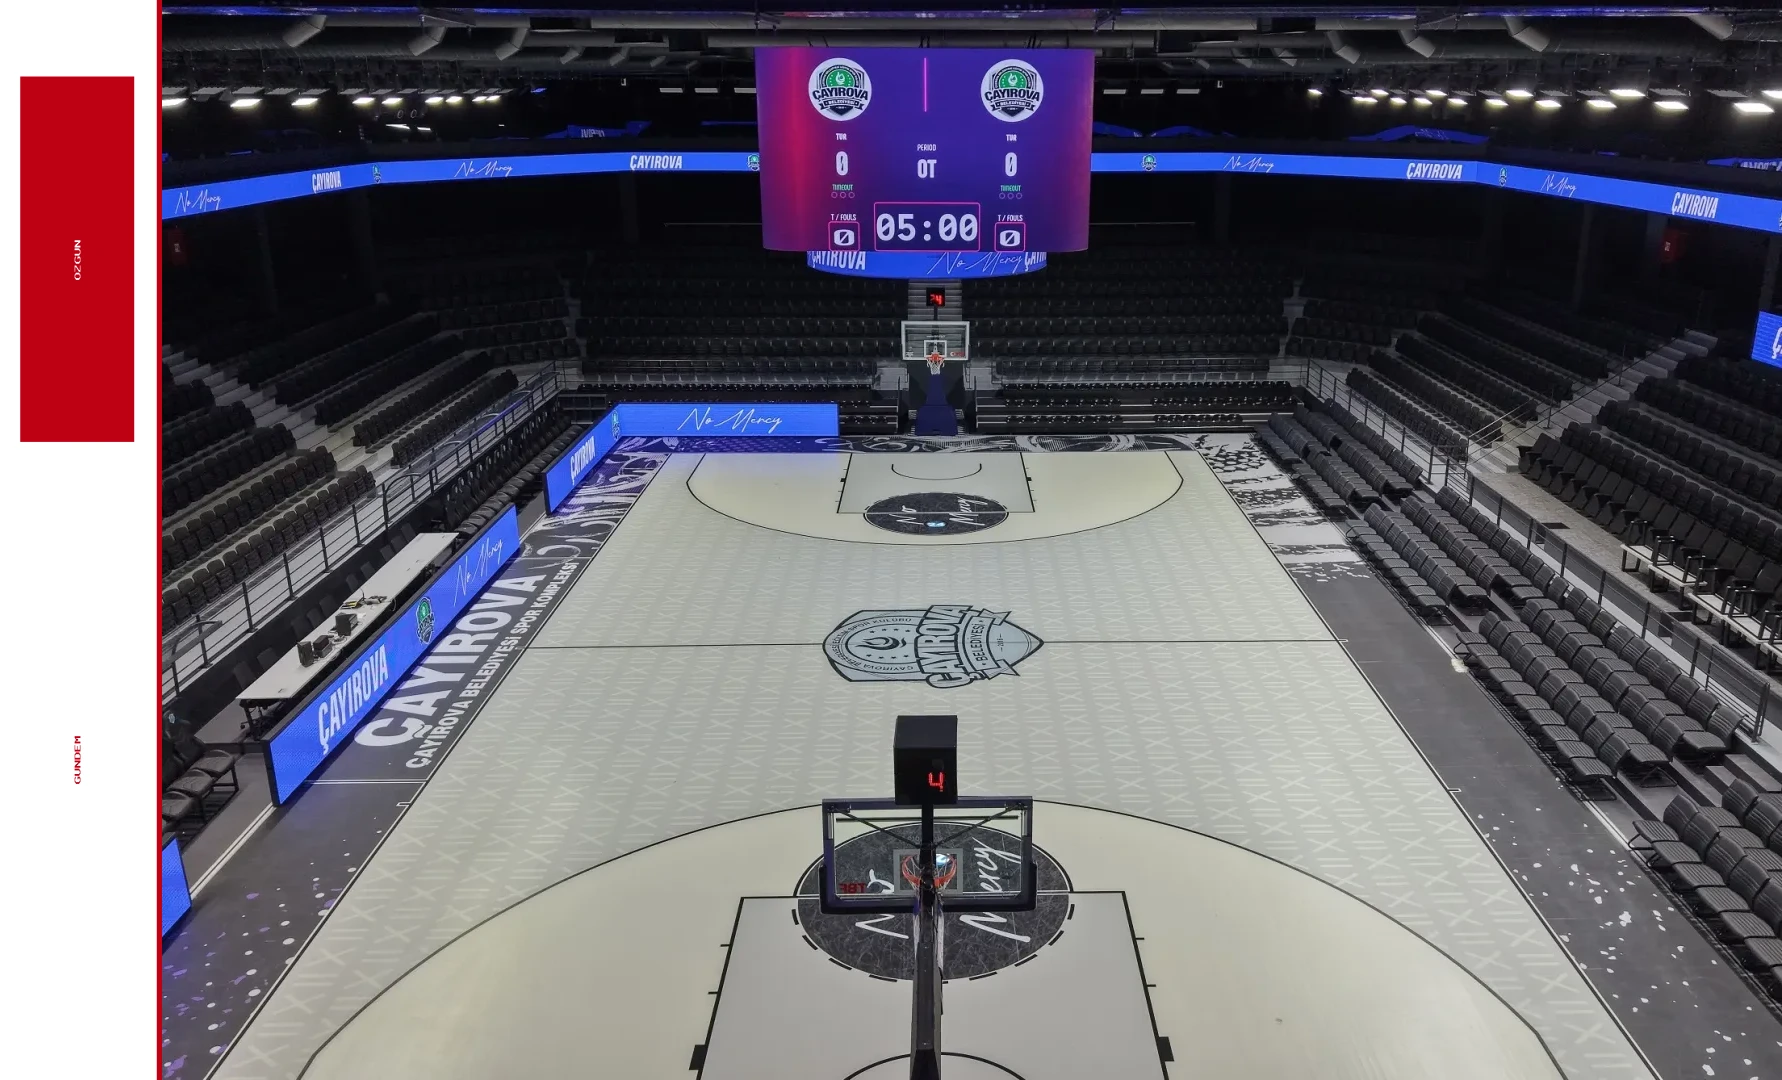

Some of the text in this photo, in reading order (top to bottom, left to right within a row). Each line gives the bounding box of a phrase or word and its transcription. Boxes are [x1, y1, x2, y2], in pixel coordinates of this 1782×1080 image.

[812, 87, 868, 102] ÇAYIROVA
[984, 88, 1040, 103] ÇAYIROVA
[454, 160, 513, 178] No Mercy
[630, 154, 682, 172] ÇAYIROVA
[836, 151, 848, 176] 0
[917, 159, 937, 178] OT
[1005, 152, 1018, 176] 0
[1223, 156, 1274, 173] No Mercy
[1406, 162, 1462, 180] ÇAYIROVA
[312, 171, 342, 194] ÇAYIROVA
[1541, 174, 1554, 192] No
[175, 188, 222, 214] No Mercy
[1672, 192, 1719, 220] ÇAYIROVA
[834, 230, 854, 246] 0
[876, 213, 978, 242] 05:00
[1000, 230, 1020, 247] 0
[812, 251, 866, 270] ÇAYIROVA
[927, 252, 1022, 276] No Mercy
[677, 407, 782, 434] No Mercy
[454, 538, 502, 607] No Mercy
[914, 604, 986, 688] ÇAYIROVA
[966, 623, 988, 662] BELEDİYESİ
[354, 574, 547, 748] ÇAYIROVA
[318, 644, 389, 755] ÇAYIROVA
[406, 700, 473, 769] ÇAYIROVA
[510, 610, 543, 634] SPOR
